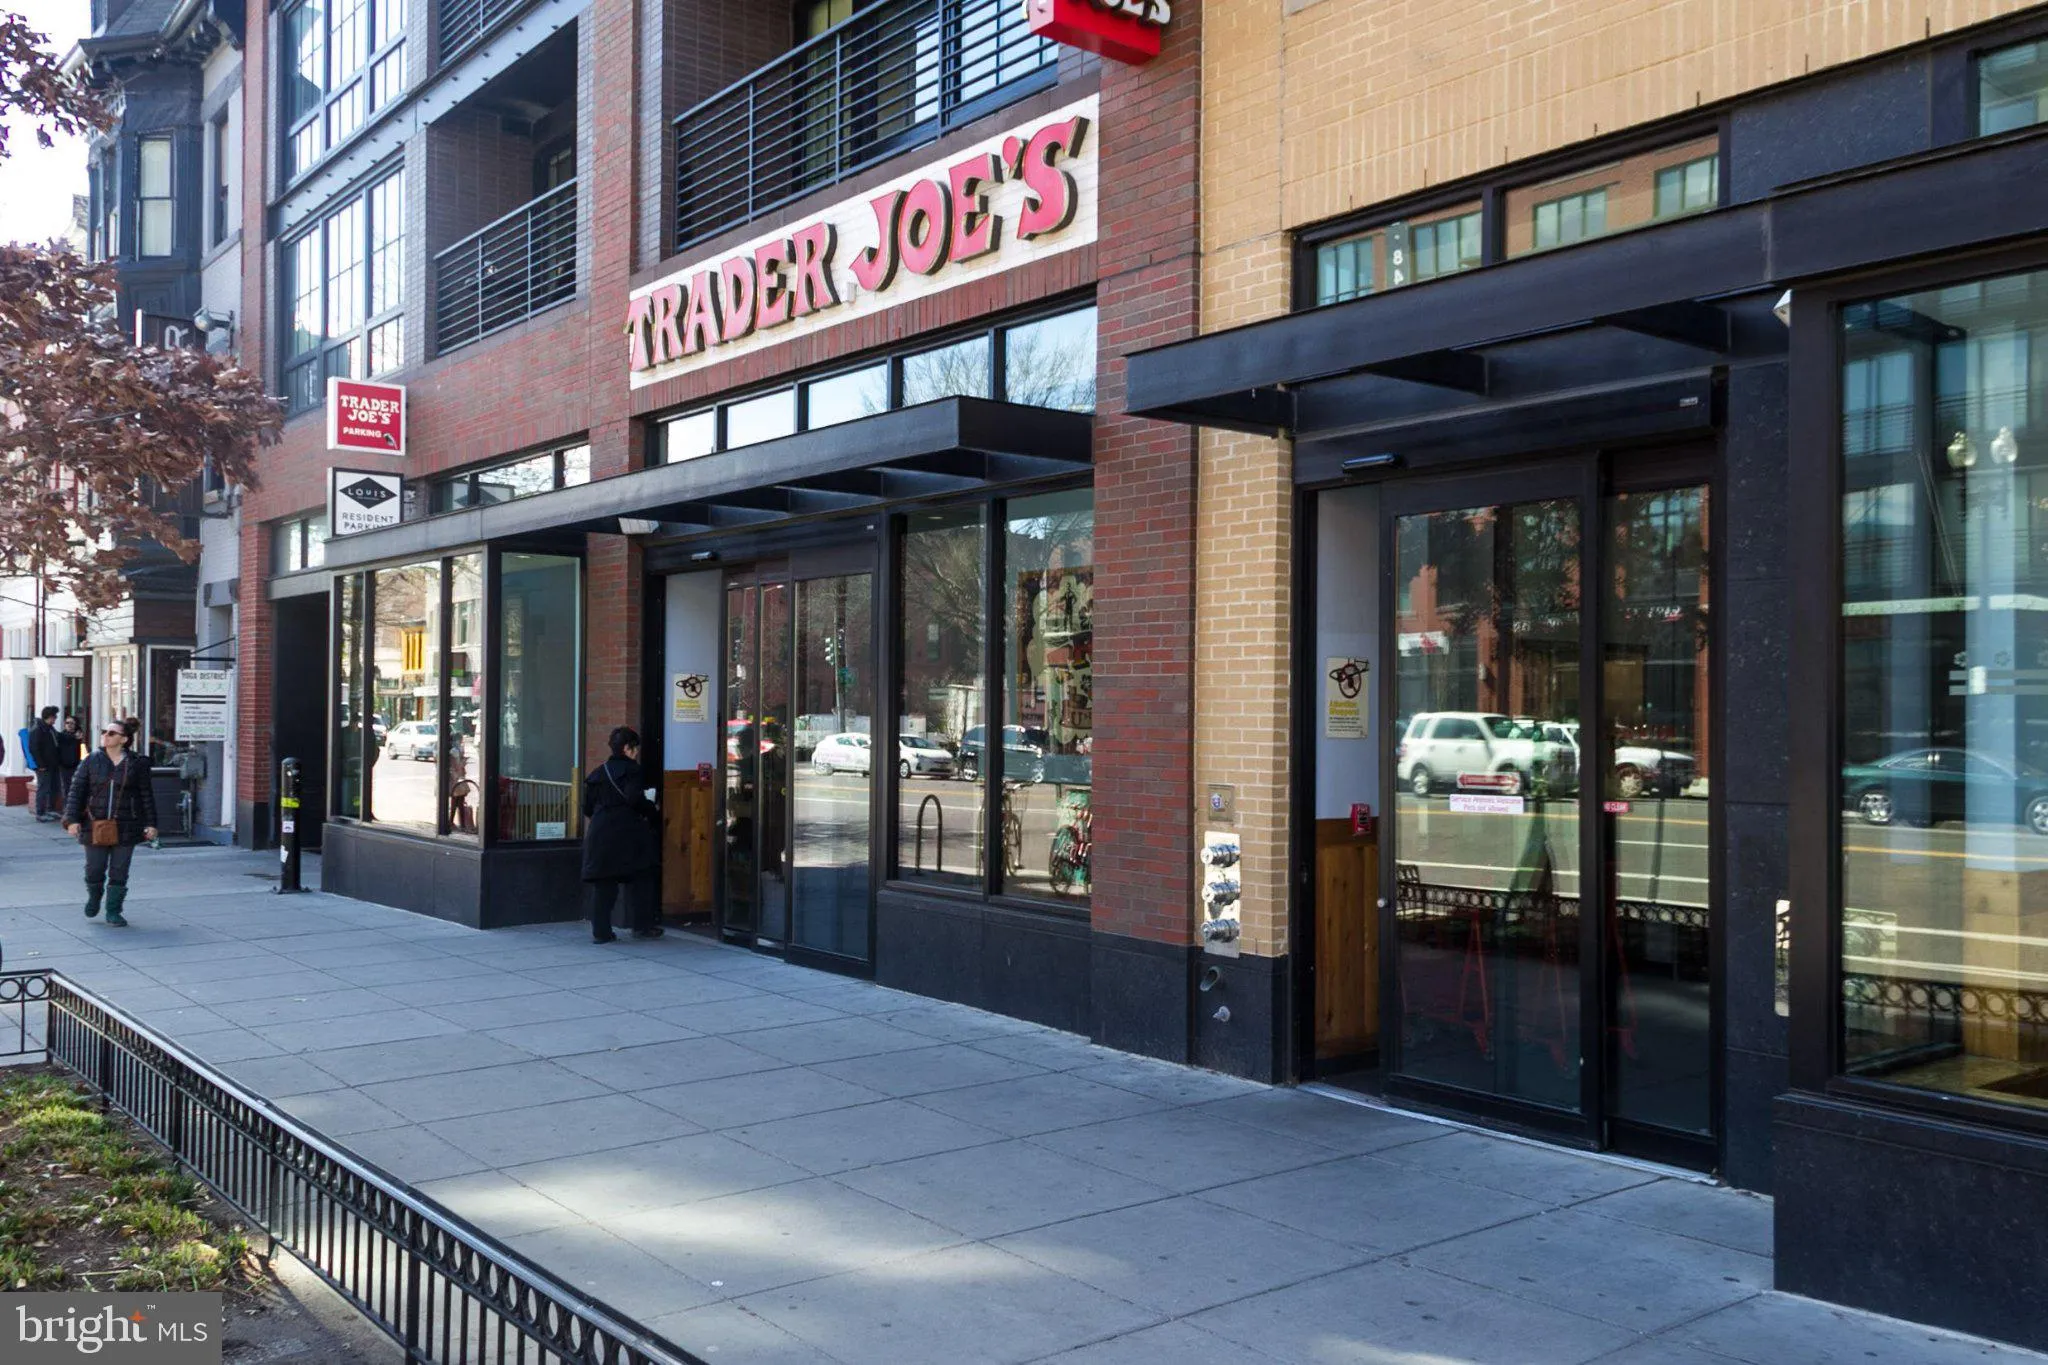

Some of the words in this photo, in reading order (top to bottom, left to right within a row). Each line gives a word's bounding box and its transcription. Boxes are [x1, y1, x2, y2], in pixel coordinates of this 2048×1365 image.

[623, 221, 841, 372] TRADER
[849, 115, 1090, 293] JOE'S
[340, 395, 400, 414] TRADER
[347, 409, 392, 425] JOE'S
[342, 426, 382, 439] PARKING
[347, 487, 387, 498] LOUIS
[342, 512, 394, 523] RESIDENT
[344, 522, 385, 531] PARK
[182, 672, 198, 680] YOGA
[199, 672, 227, 680] DISTRICT
